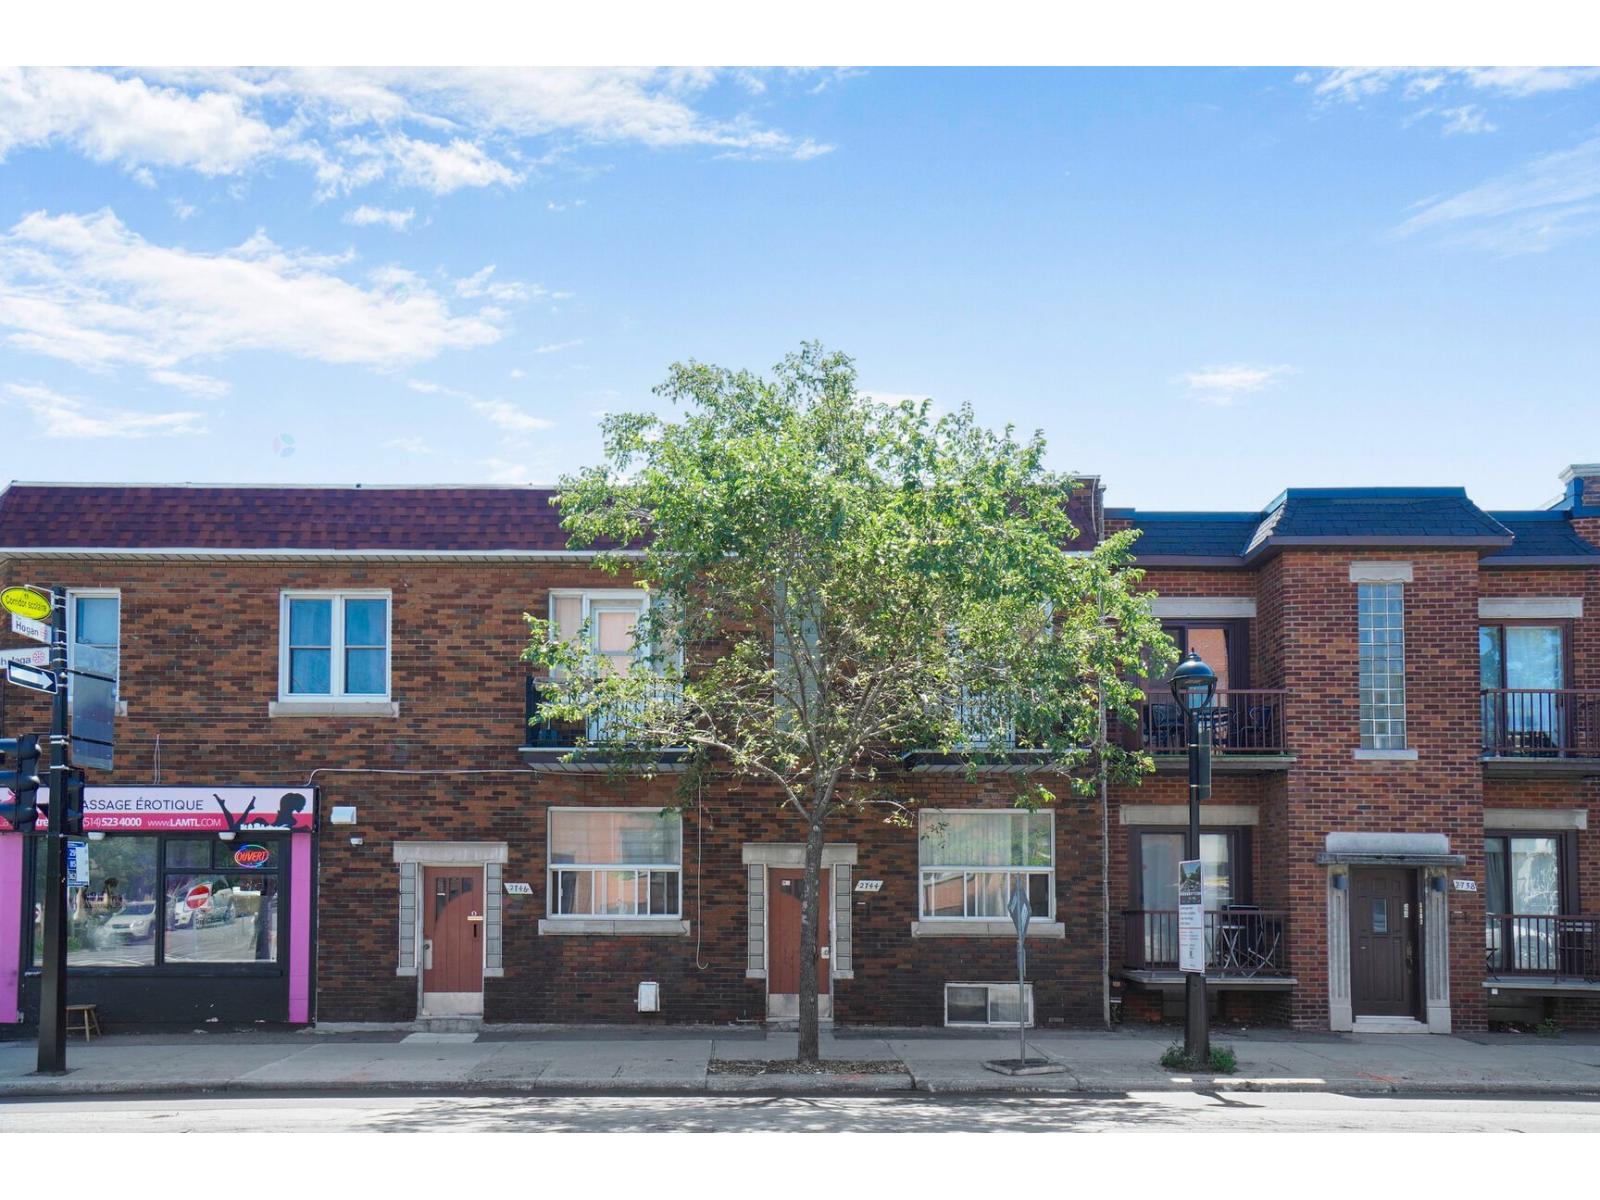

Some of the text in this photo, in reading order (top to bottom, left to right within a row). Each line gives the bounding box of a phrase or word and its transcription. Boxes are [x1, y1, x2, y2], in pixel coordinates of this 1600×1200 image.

[16, 620, 39, 637] Hogan
[83, 796, 204, 811] ASSAGE ÉROTIQUE
[147, 817, 222, 827] www.LAMTL.COM
[236, 850, 267, 862] OUVERT
